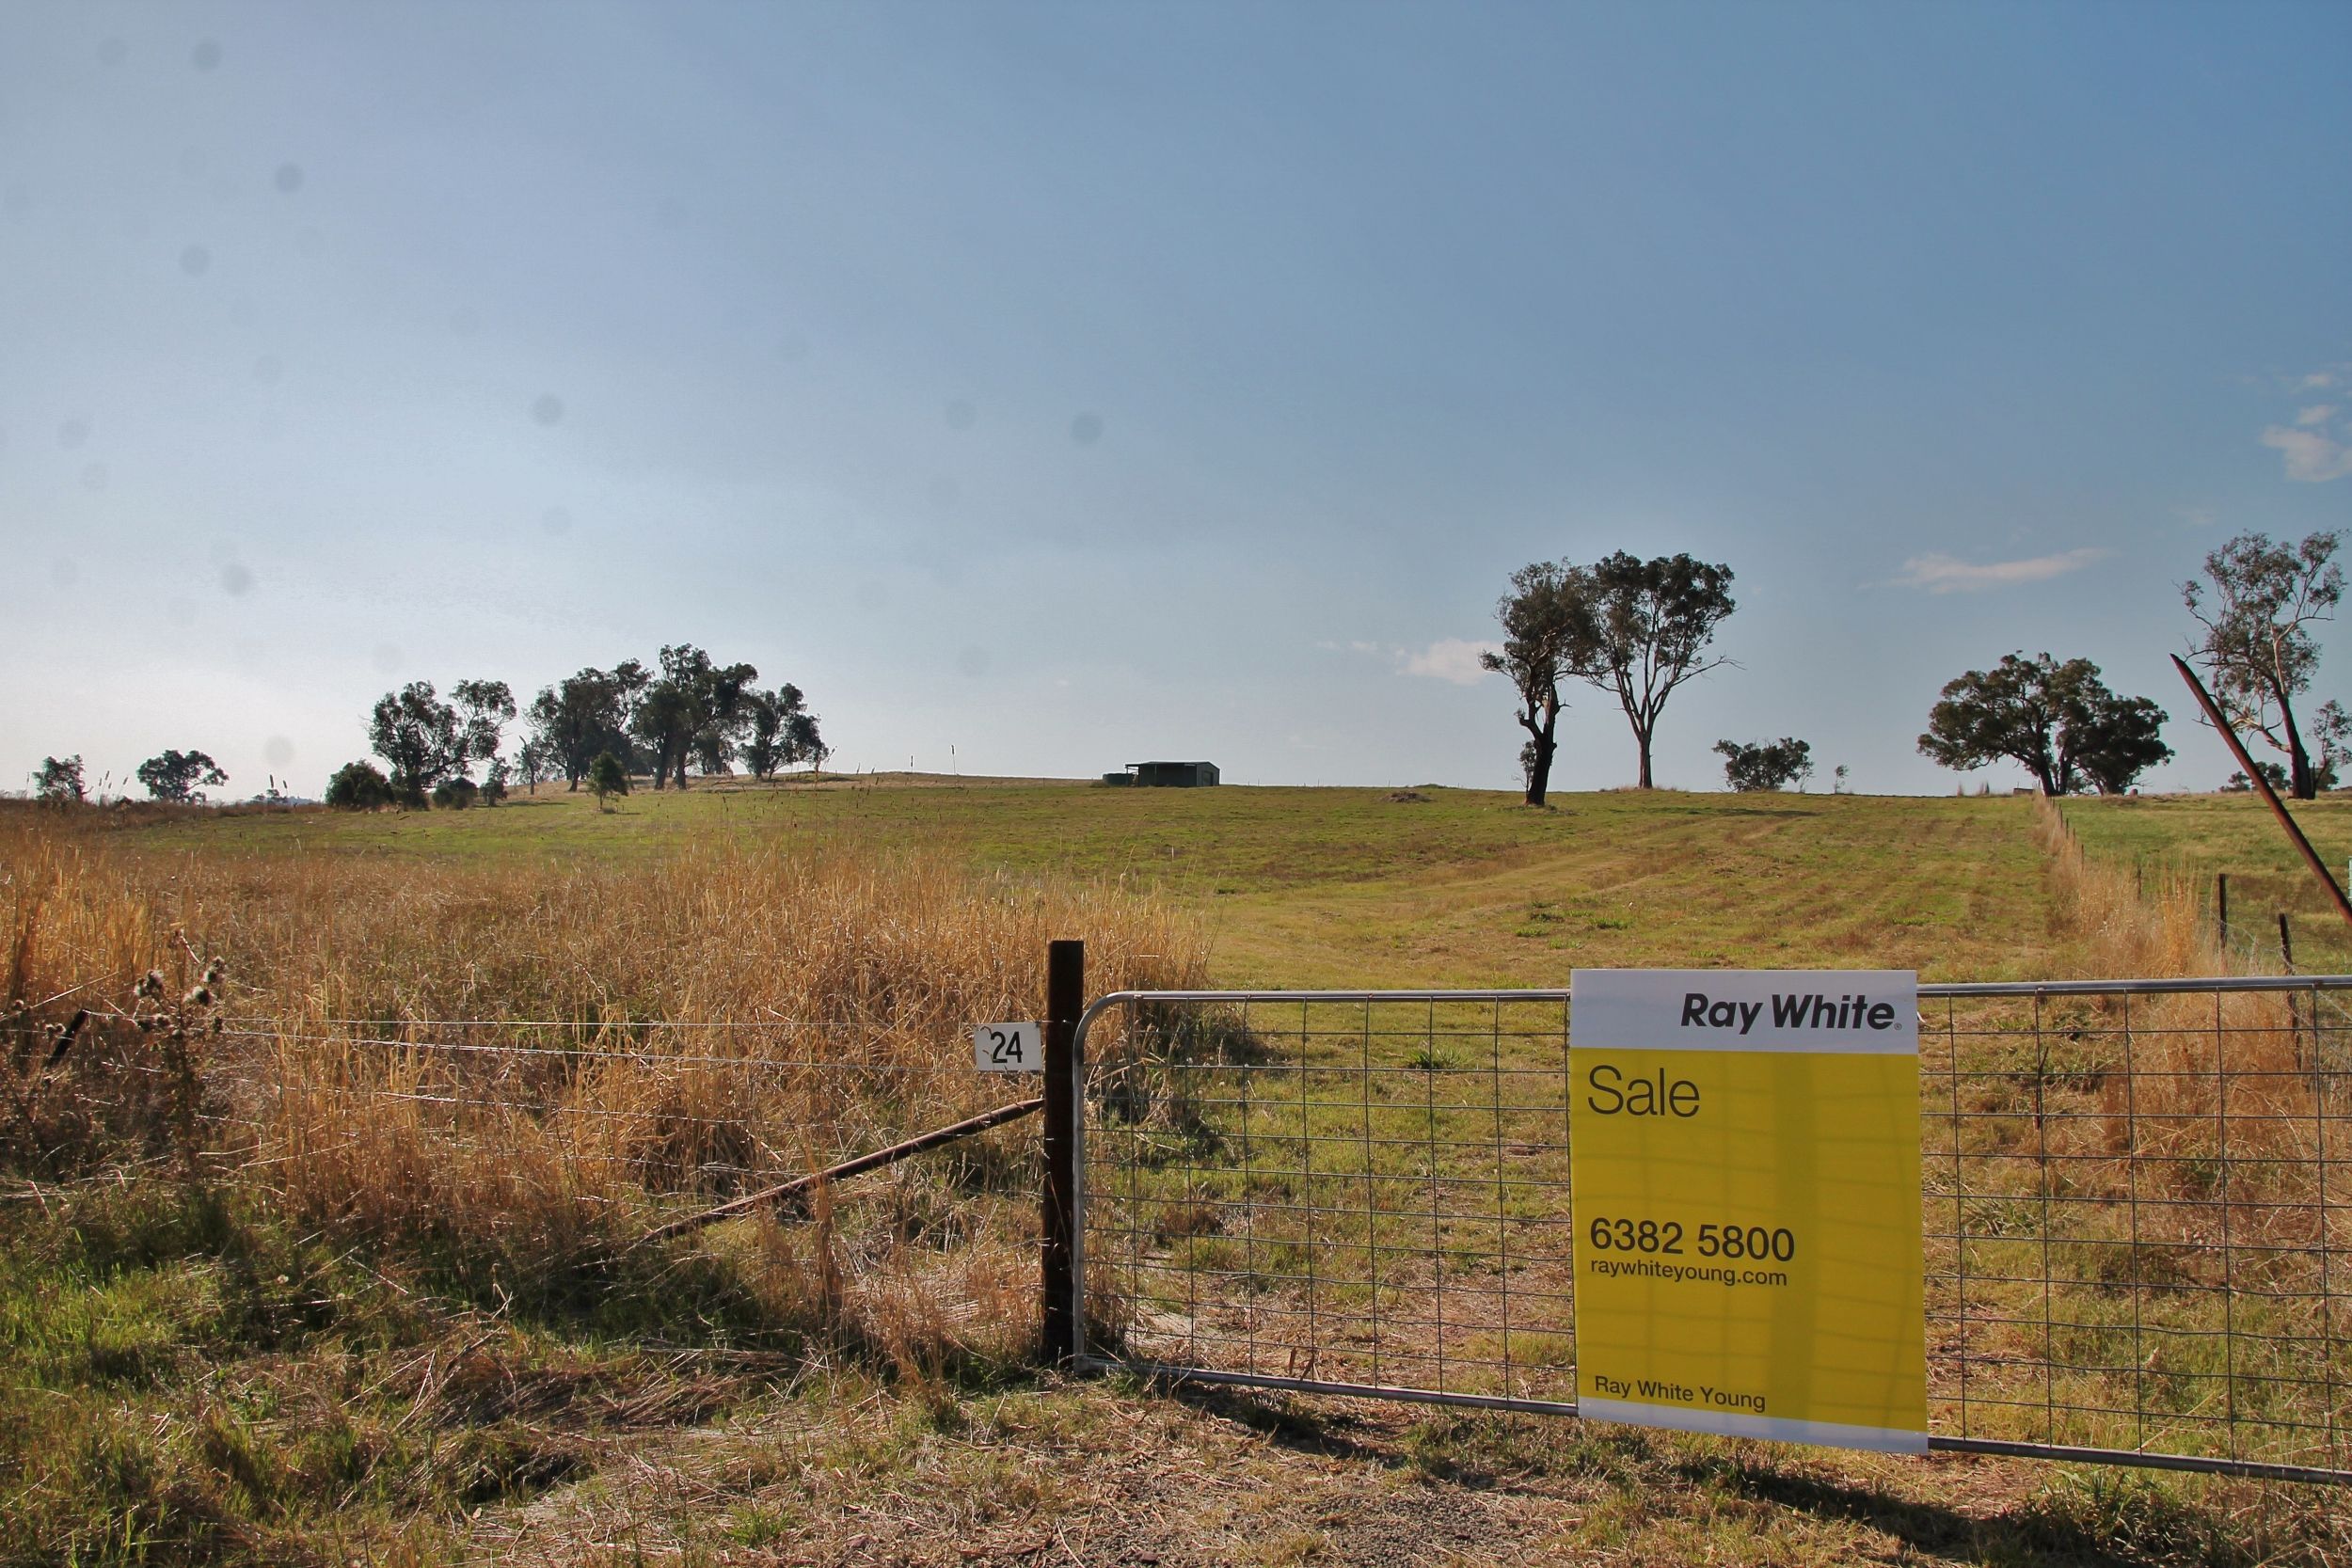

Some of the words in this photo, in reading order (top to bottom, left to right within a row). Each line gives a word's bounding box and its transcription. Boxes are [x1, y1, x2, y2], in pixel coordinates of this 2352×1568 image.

[1681, 993, 1763, 1035] Ray
[1772, 994, 1895, 1030] White
[991, 1031, 1023, 1063] 24
[1587, 1065, 1700, 1117] Sale
[1590, 1217, 1683, 1255] 6382
[1697, 1224, 1794, 1261] 5800
[1591, 1258, 1787, 1287] raywhiteyoung.com
[1595, 1375, 1631, 1399] Ray
[1637, 1380, 1693, 1402] White
[1700, 1386, 1766, 1413] Young
